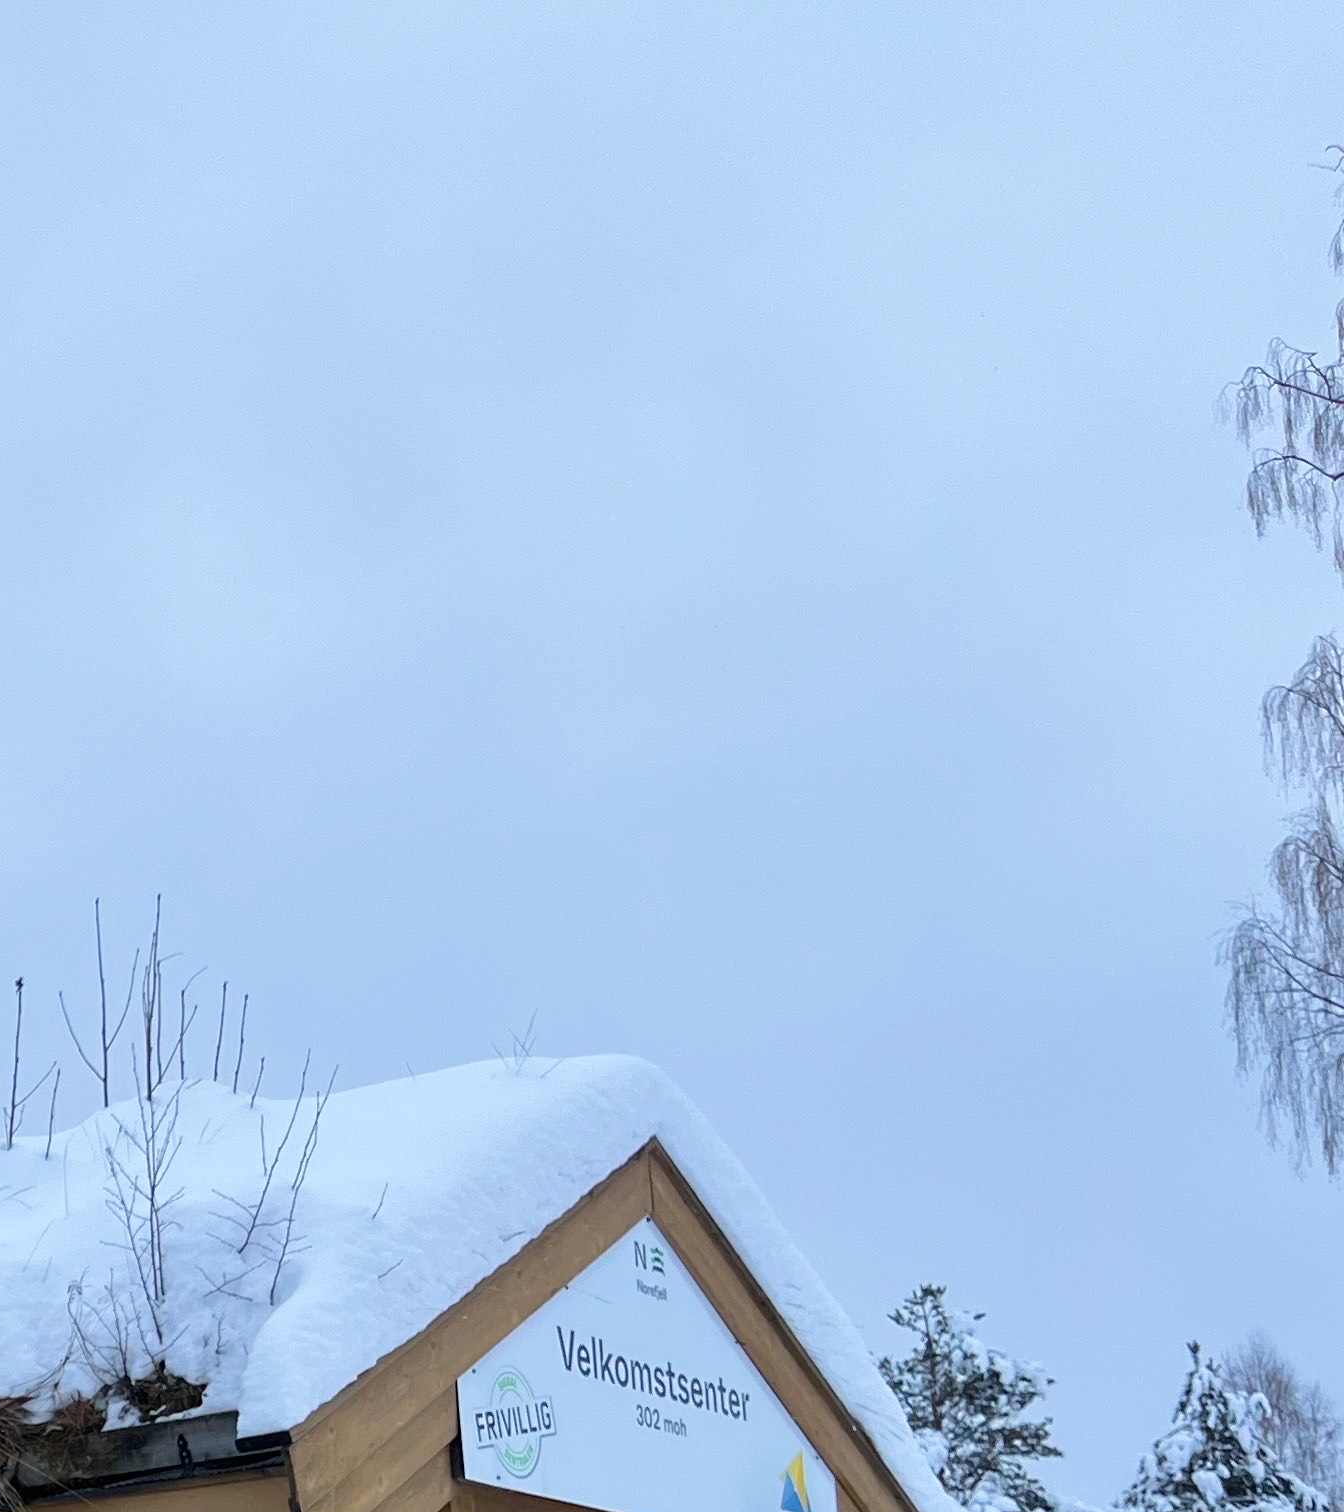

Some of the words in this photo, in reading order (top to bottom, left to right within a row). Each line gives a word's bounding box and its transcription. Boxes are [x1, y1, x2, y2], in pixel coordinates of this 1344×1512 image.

[636, 1279, 667, 1301] Norefjell
[556, 1325, 750, 1421] Velkomstsenter
[475, 1401, 552, 1442] FRIVILLIG
[635, 1403, 661, 1431] 302
[663, 1417, 687, 1438] moh
